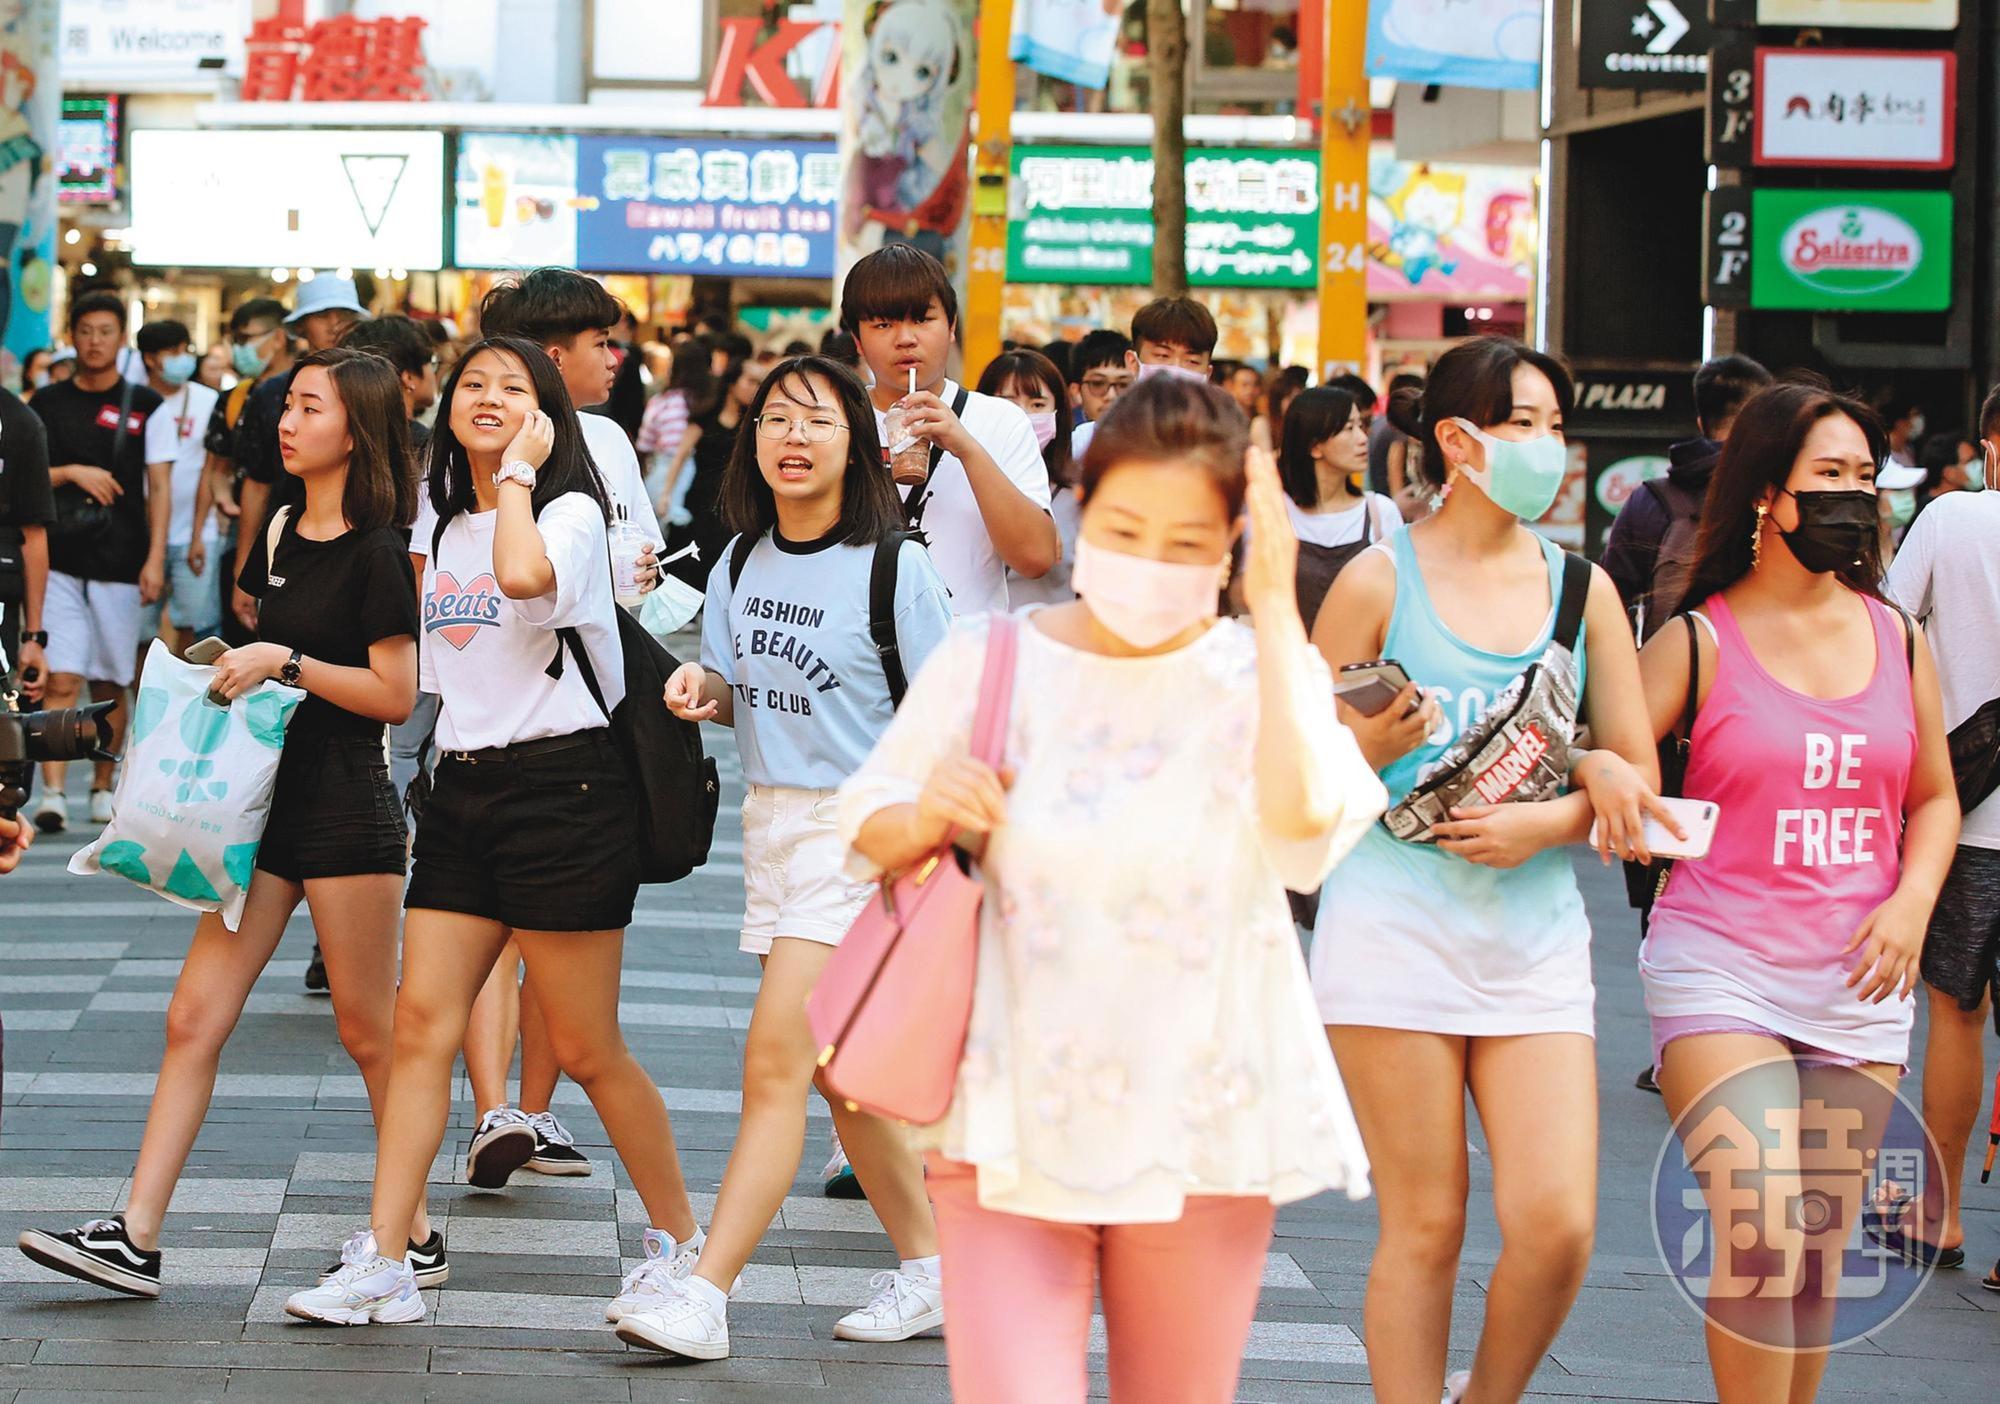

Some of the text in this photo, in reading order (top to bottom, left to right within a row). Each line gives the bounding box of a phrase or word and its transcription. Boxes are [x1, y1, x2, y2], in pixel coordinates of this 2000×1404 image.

[111, 26, 224, 51] Welcome
[1604, 52, 1707, 72] CONVERSE
[1333, 183, 1360, 212] H
[1326, 243, 1365, 273] 24
[1584, 383, 1667, 412] PLAZA
[424, 589, 502, 624] beats
[751, 629, 841, 693] BEAUTY
[767, 689, 812, 717] CLUB
[1474, 726, 1547, 803] MARVEL
[1802, 733, 1868, 790] BE
[1773, 807, 1882, 866] FREE
